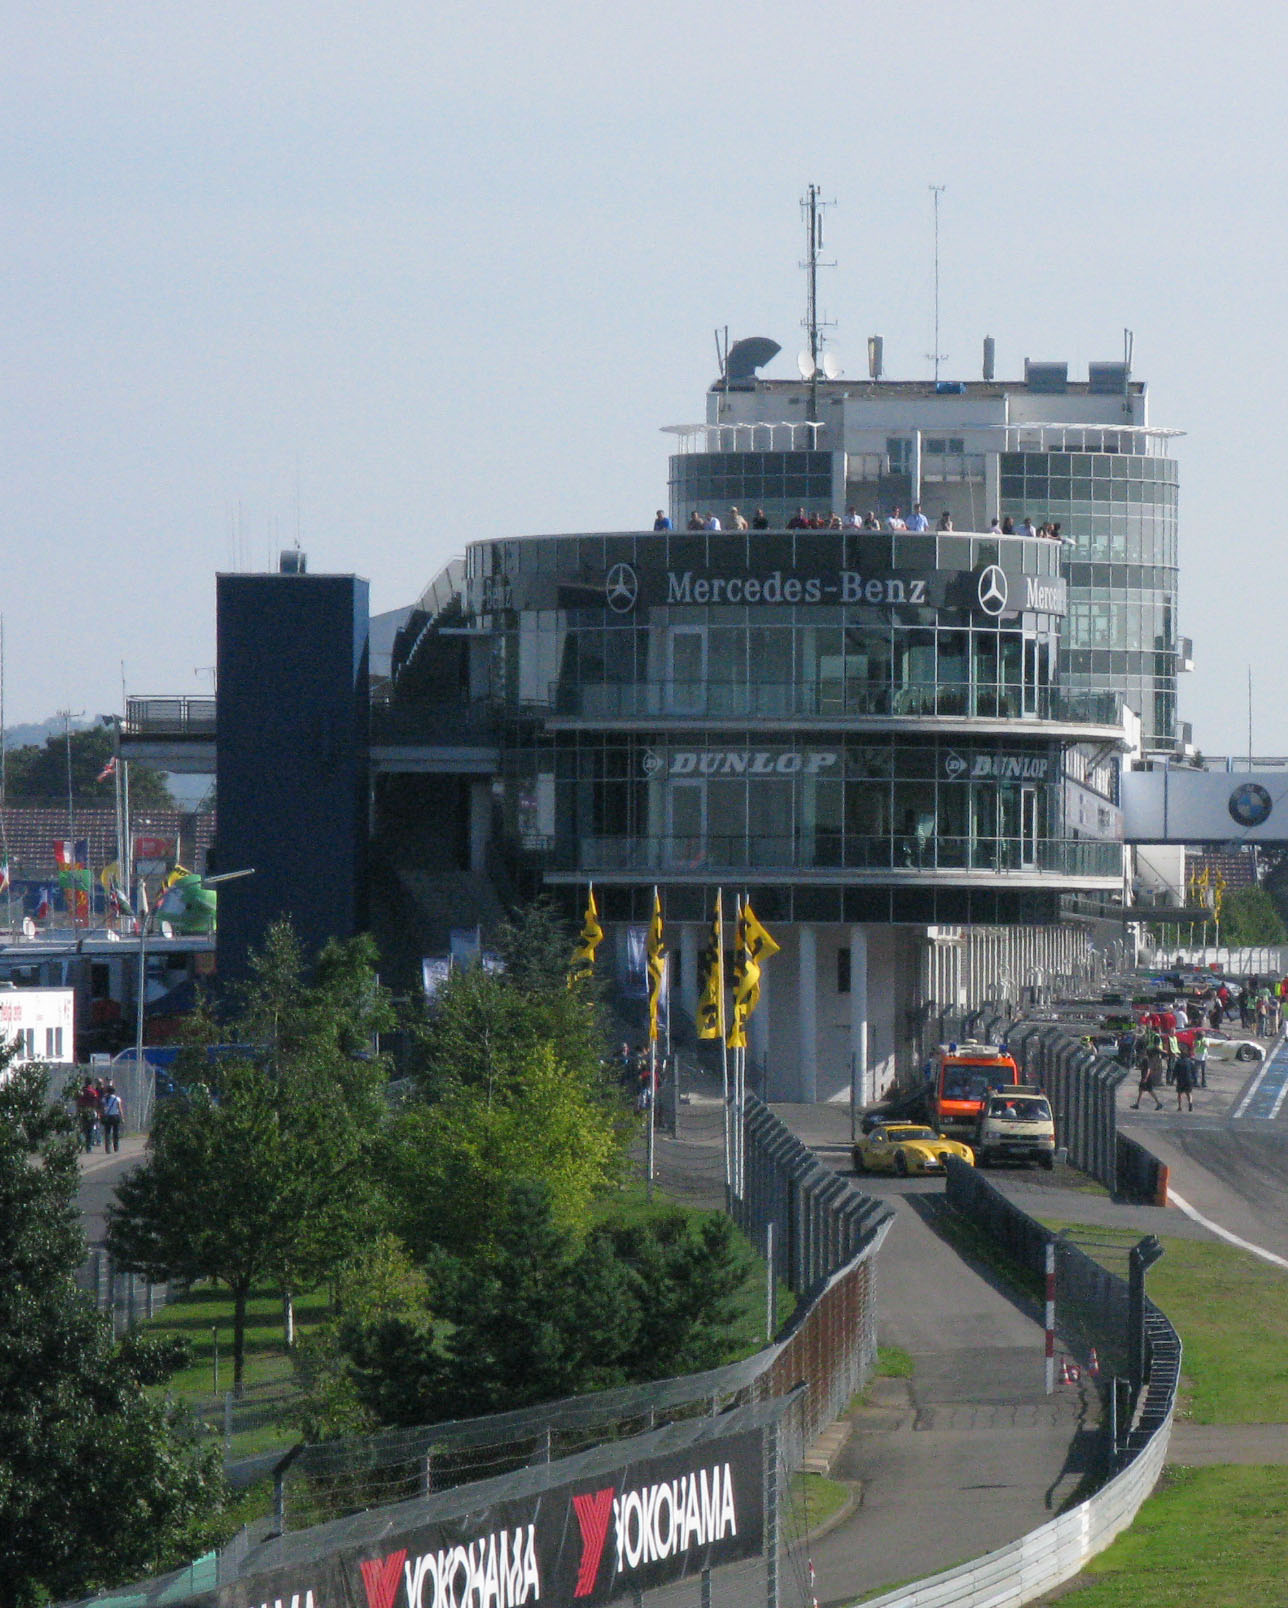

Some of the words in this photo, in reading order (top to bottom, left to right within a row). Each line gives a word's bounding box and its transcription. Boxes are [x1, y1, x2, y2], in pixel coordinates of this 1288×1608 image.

[666, 570, 926, 604] Mercedes-Benz
[669, 752, 837, 773] DUNLOP
[970, 755, 1048, 778] DUNLOP
[613, 1463, 737, 1573] YOKOHAMA
[404, 1524, 540, 1608] YOKOHAMA
